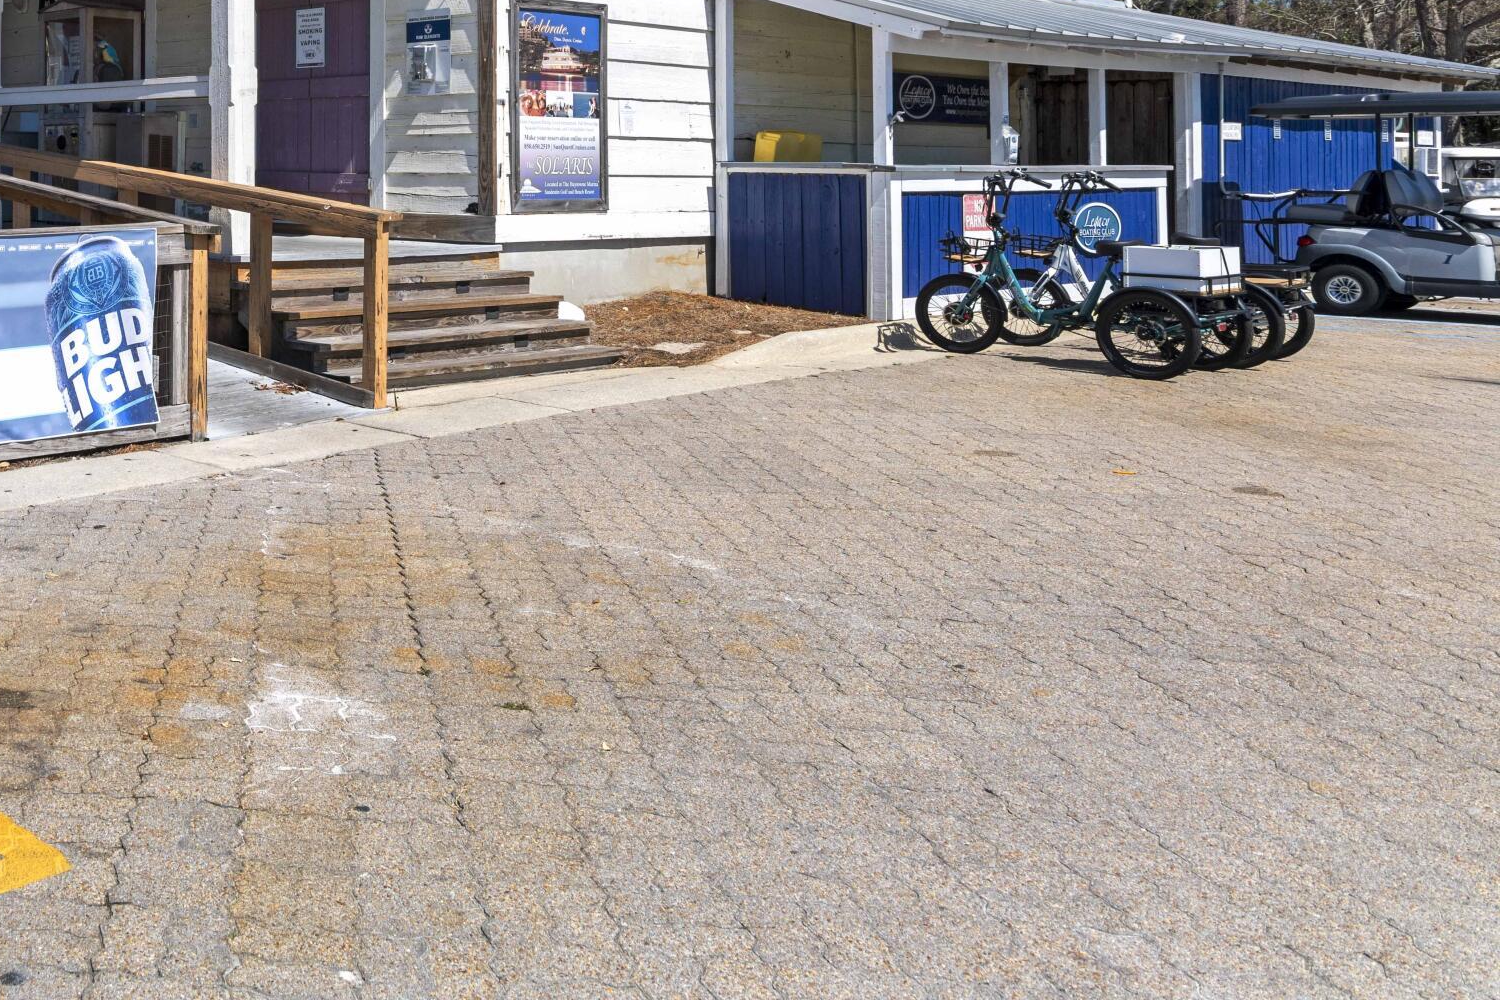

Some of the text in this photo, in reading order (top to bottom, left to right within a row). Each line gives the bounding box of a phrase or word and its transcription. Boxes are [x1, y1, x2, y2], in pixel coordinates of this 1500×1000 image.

[522, 12, 569, 35] Celebrate.
[535, 156, 594, 175] SOLARIS
[974, 199, 984, 214] NO
[1084, 210, 1110, 233] Legacy
[60, 307, 149, 379] BUD
